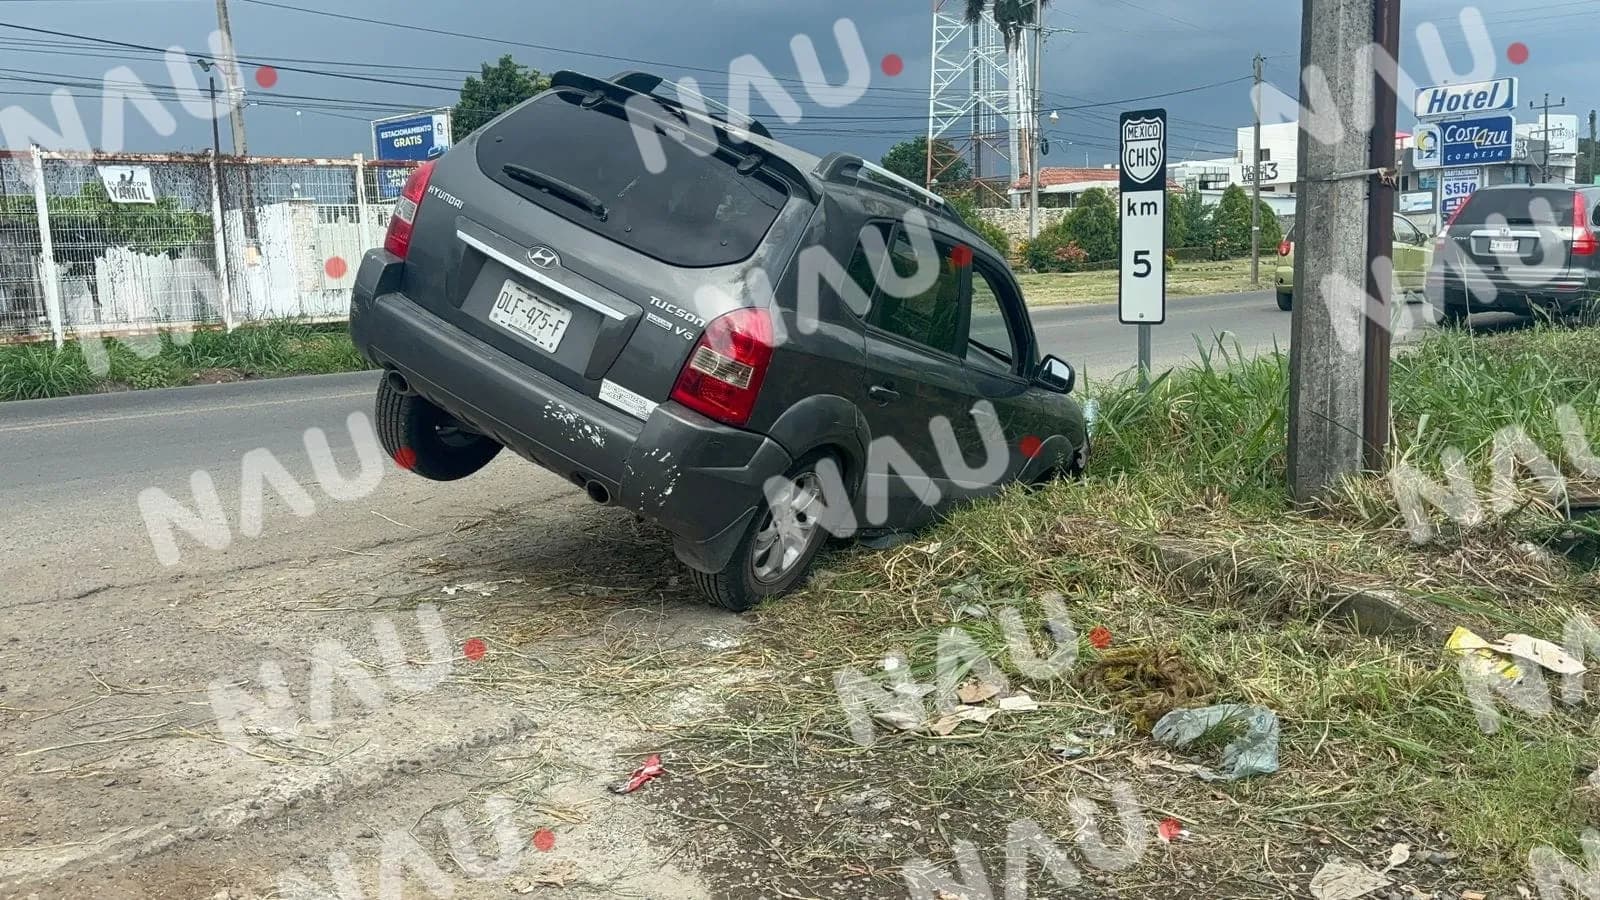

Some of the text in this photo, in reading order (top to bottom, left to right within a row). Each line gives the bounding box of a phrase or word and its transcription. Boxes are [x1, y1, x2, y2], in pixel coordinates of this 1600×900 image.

[1427, 82, 1499, 113] Hotel
[381, 124, 432, 139] ESTACIONAMIENTO
[1127, 124, 1158, 139] MEXICO
[393, 135, 423, 148] GRATIS
[1128, 147, 1157, 167] CHIS
[109, 186, 151, 200] YAMIL
[1445, 182, 1477, 195] $550
[427, 185, 464, 210] HYUNDAI
[1127, 198, 1158, 216] km
[1132, 250, 1152, 278] 5
[649, 295, 706, 328] TUCSON
[675, 326, 695, 341] V6
